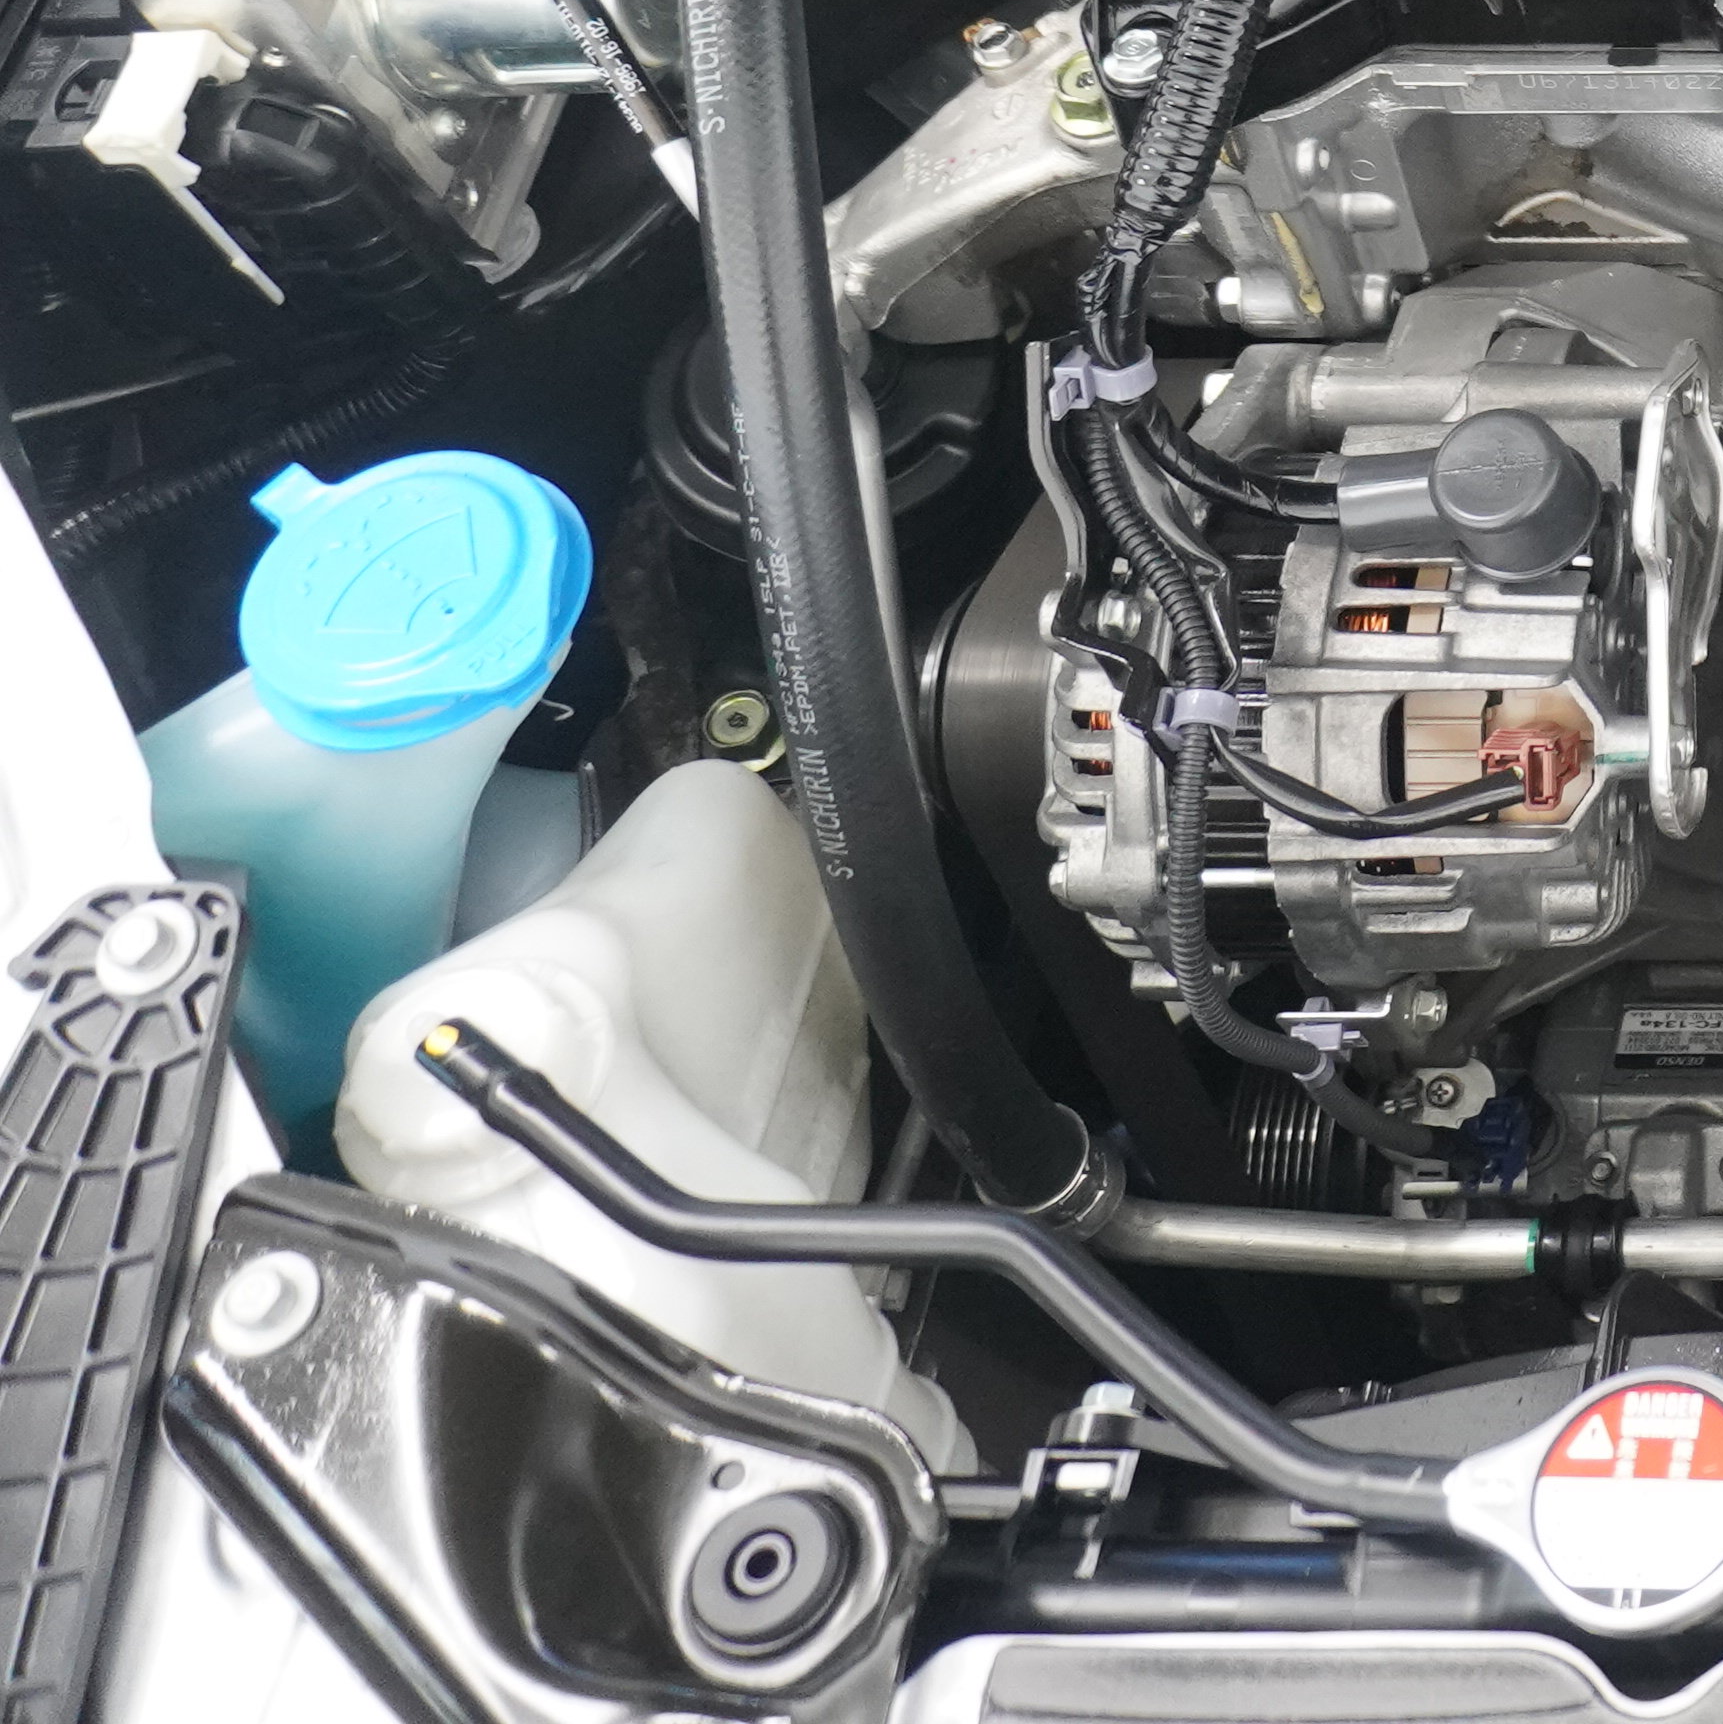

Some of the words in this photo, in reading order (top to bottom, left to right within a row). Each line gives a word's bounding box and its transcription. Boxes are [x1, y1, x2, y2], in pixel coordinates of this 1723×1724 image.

[466, 622, 538, 678] PULL
[1655, 1056, 1705, 1066] DENSO
[1623, 1391, 1704, 1417] DANGER
